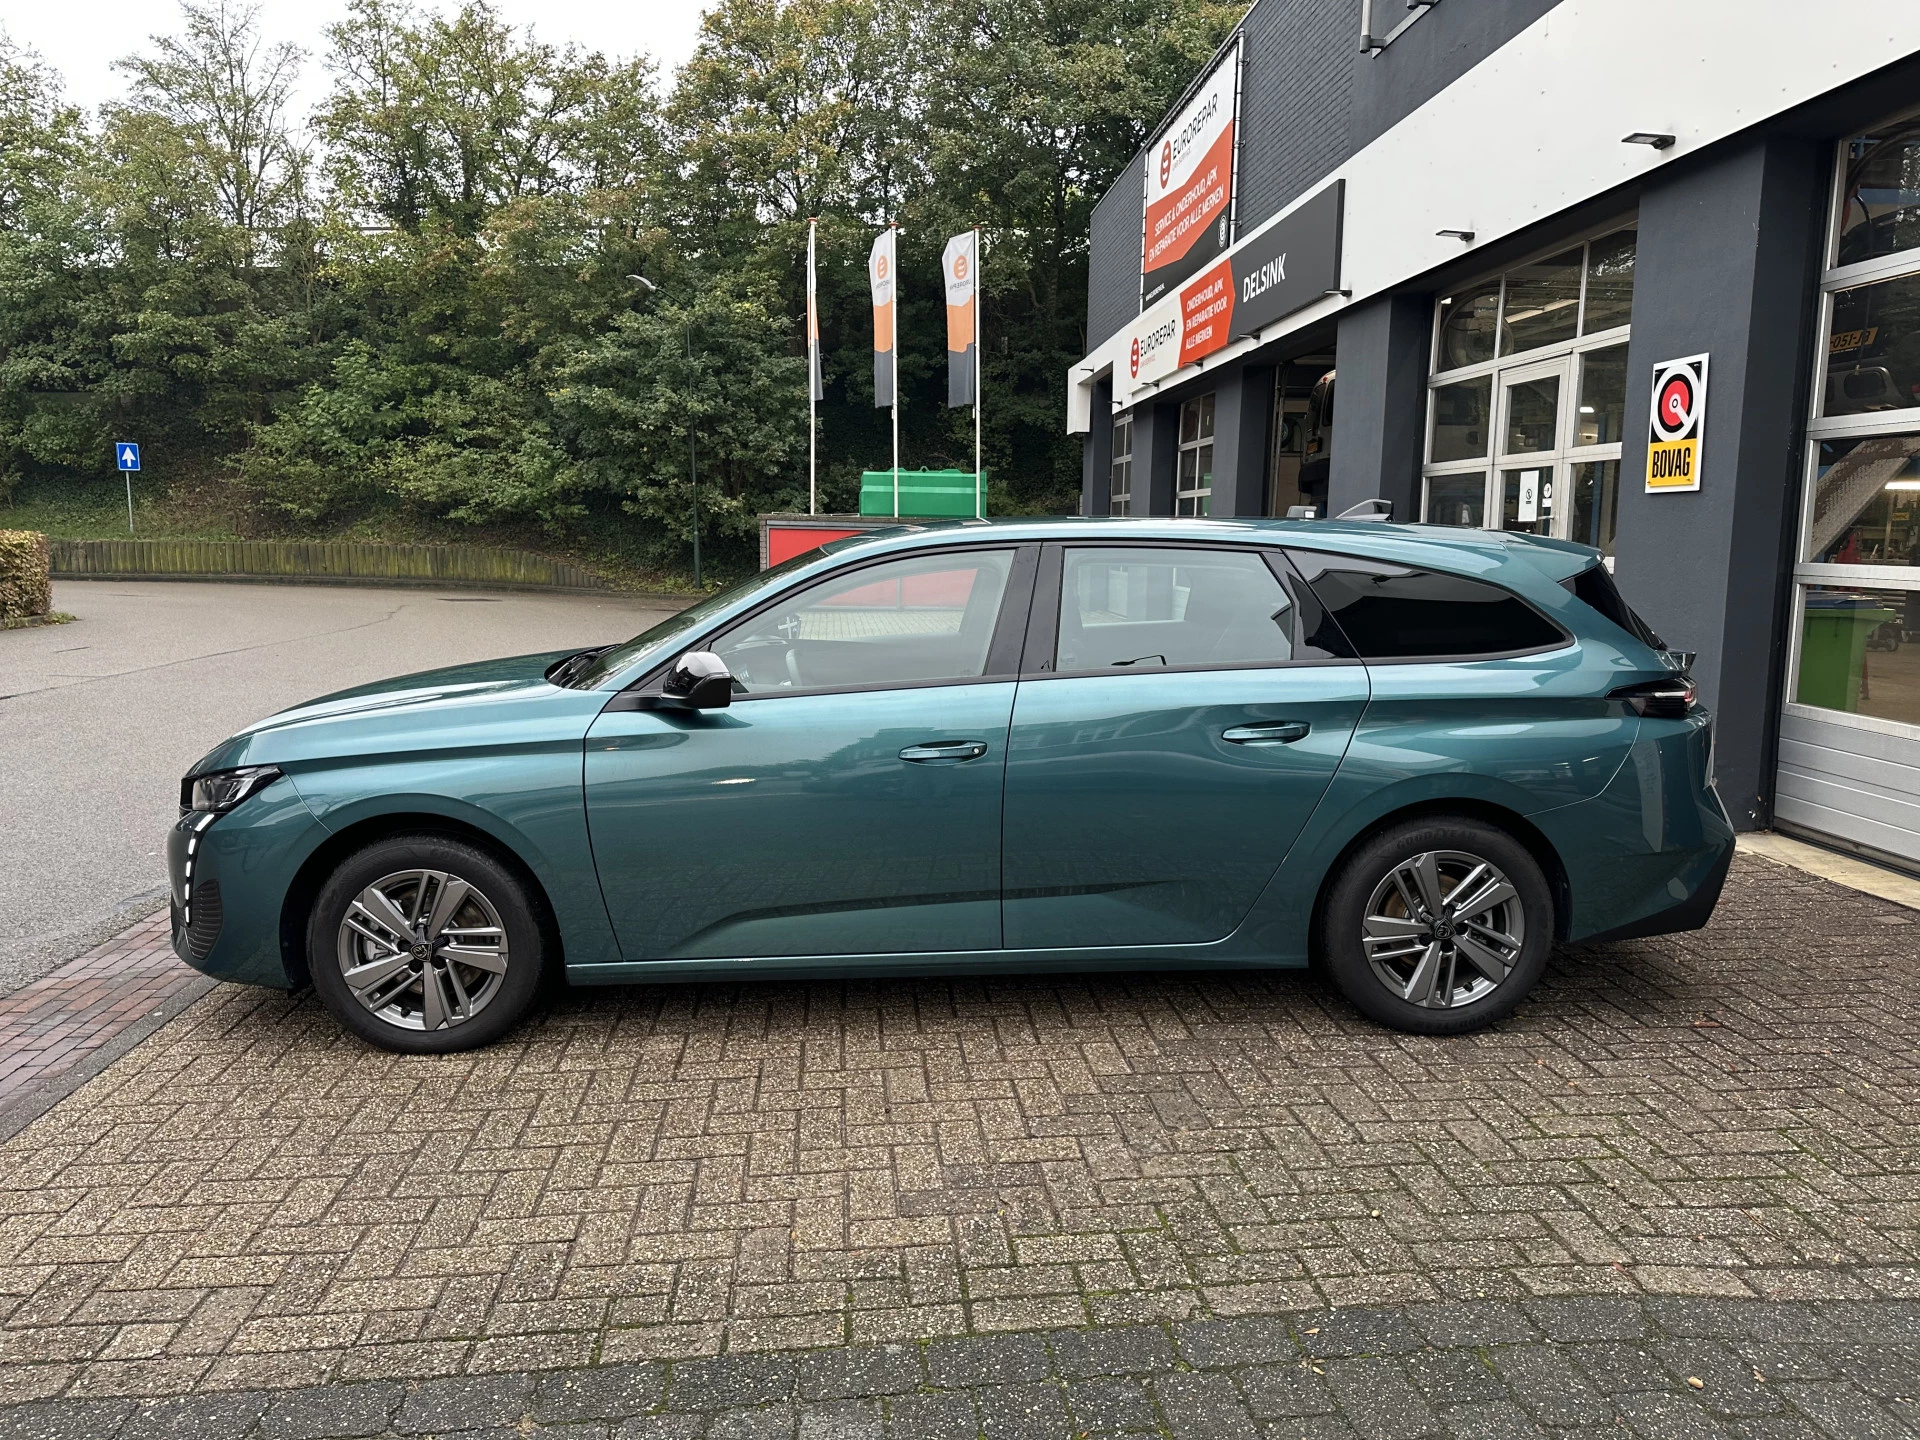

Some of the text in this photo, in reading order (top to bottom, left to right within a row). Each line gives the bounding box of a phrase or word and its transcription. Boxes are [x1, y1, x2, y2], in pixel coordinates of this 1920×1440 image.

[1173, 93, 1217, 160] EUROREPAR
[1155, 210, 1172, 237] SERVICE
[1176, 178, 1205, 216] ONDERHOUD,
[1206, 165, 1218, 188] APK
[1149, 183, 1224, 262] EN REPARATIE VOOR ALLE MERKEN
[1213, 277, 1224, 295] APK
[1243, 252, 1286, 303] DELSINK
[1186, 295, 1227, 332] EN REPARATIE VOOR
[1140, 319, 1176, 357] EUROREPAR
[1185, 324, 1213, 350] ALLE MERKEN
[1651, 446, 1691, 478] BOVAG
